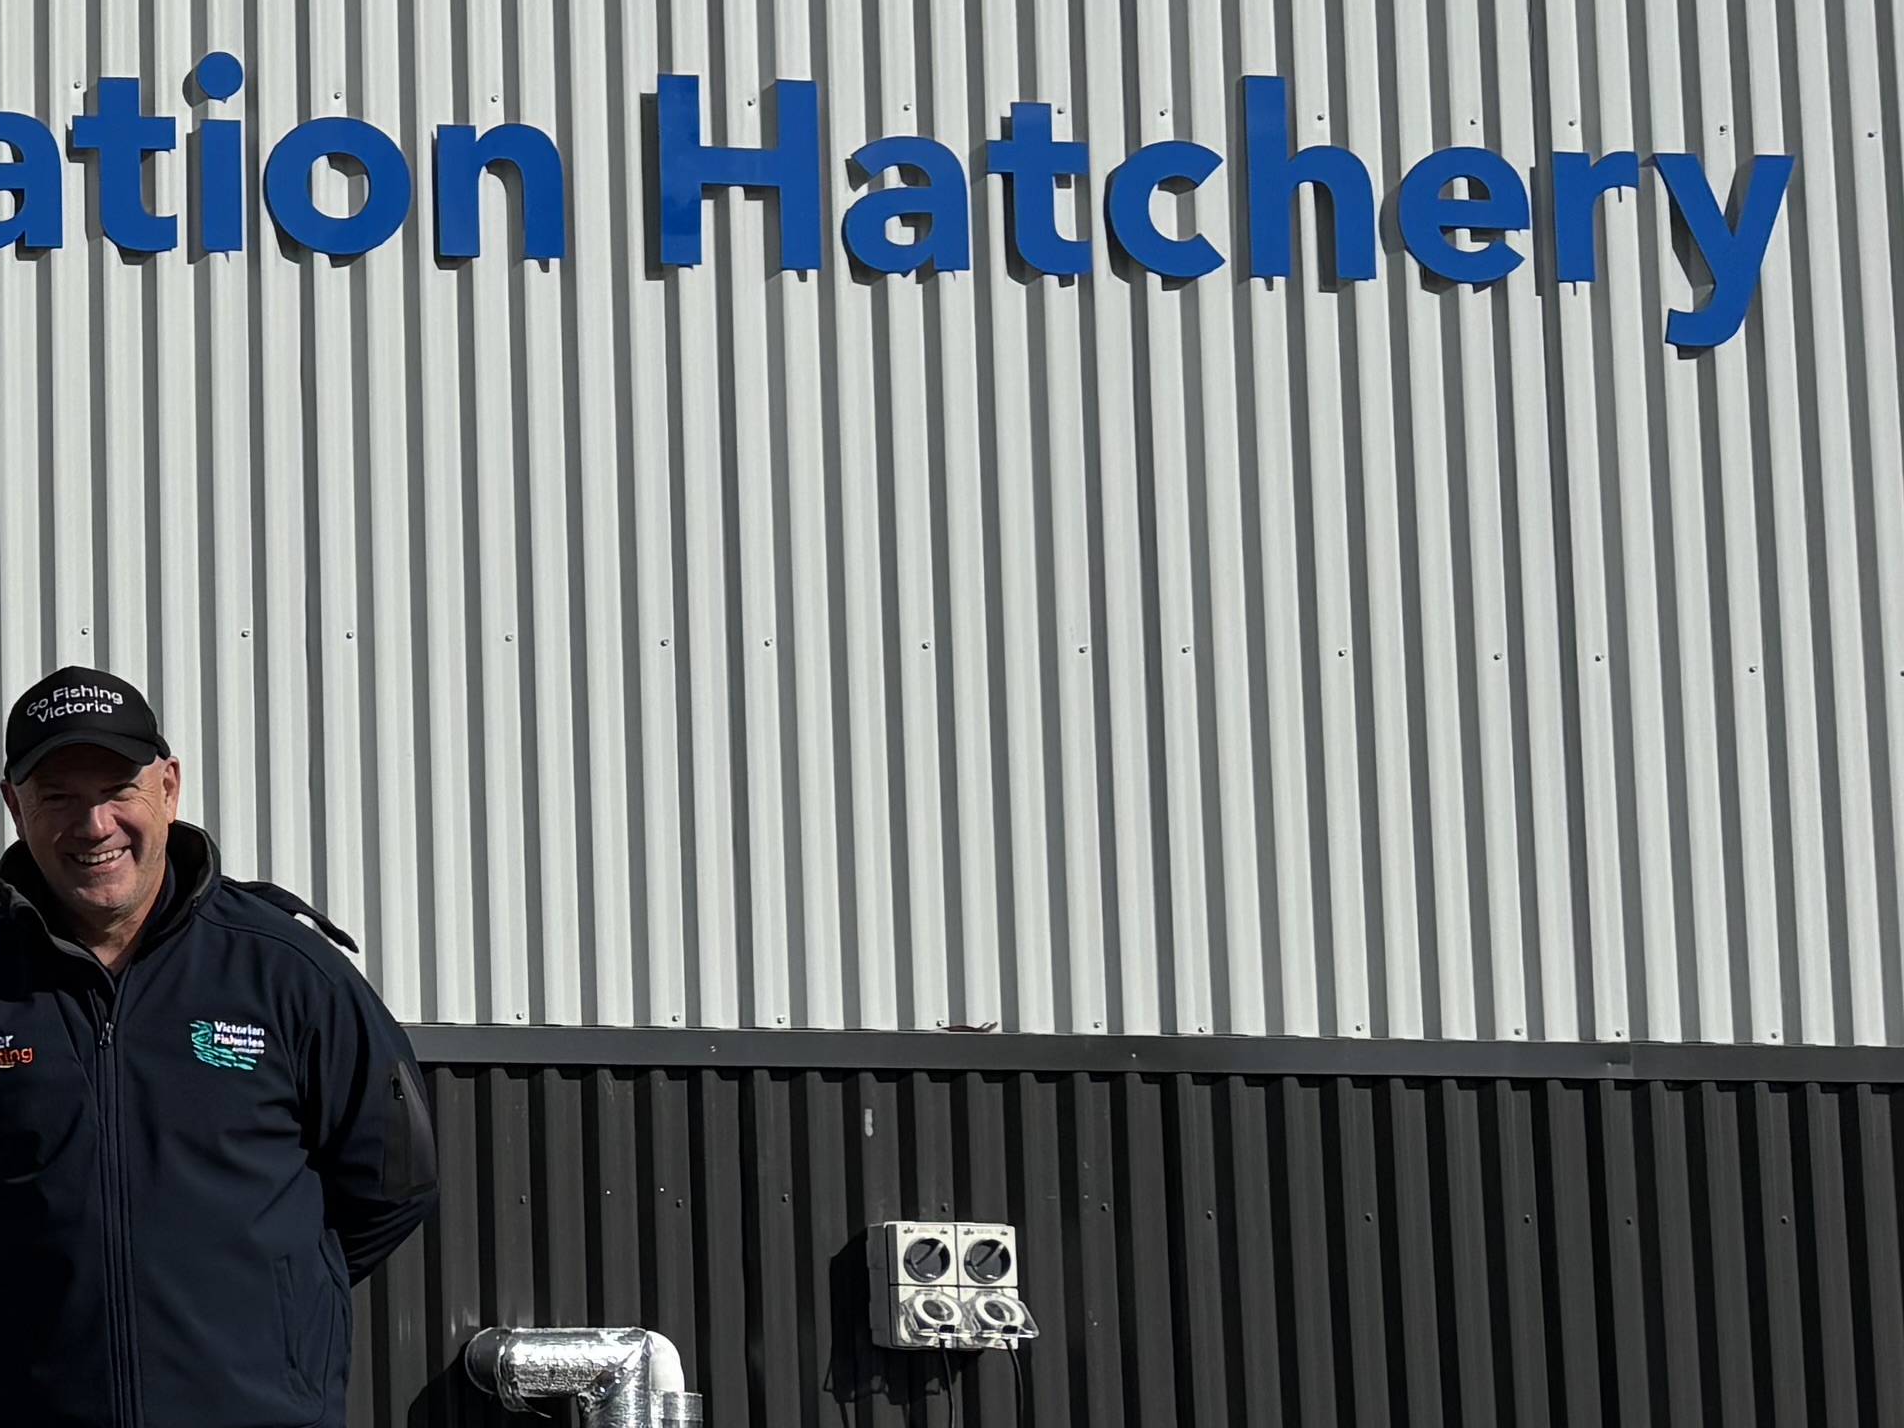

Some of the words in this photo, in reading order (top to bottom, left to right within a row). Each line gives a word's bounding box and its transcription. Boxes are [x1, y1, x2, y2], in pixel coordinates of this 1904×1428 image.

[655, 73, 1797, 350] Hatchery
[26, 698, 49, 717] Go
[53, 684, 123, 705] Fishing
[37, 700, 113, 723] Victoria
[213, 1020, 265, 1036] Victorian
[213, 1033, 265, 1048] Fisheries
